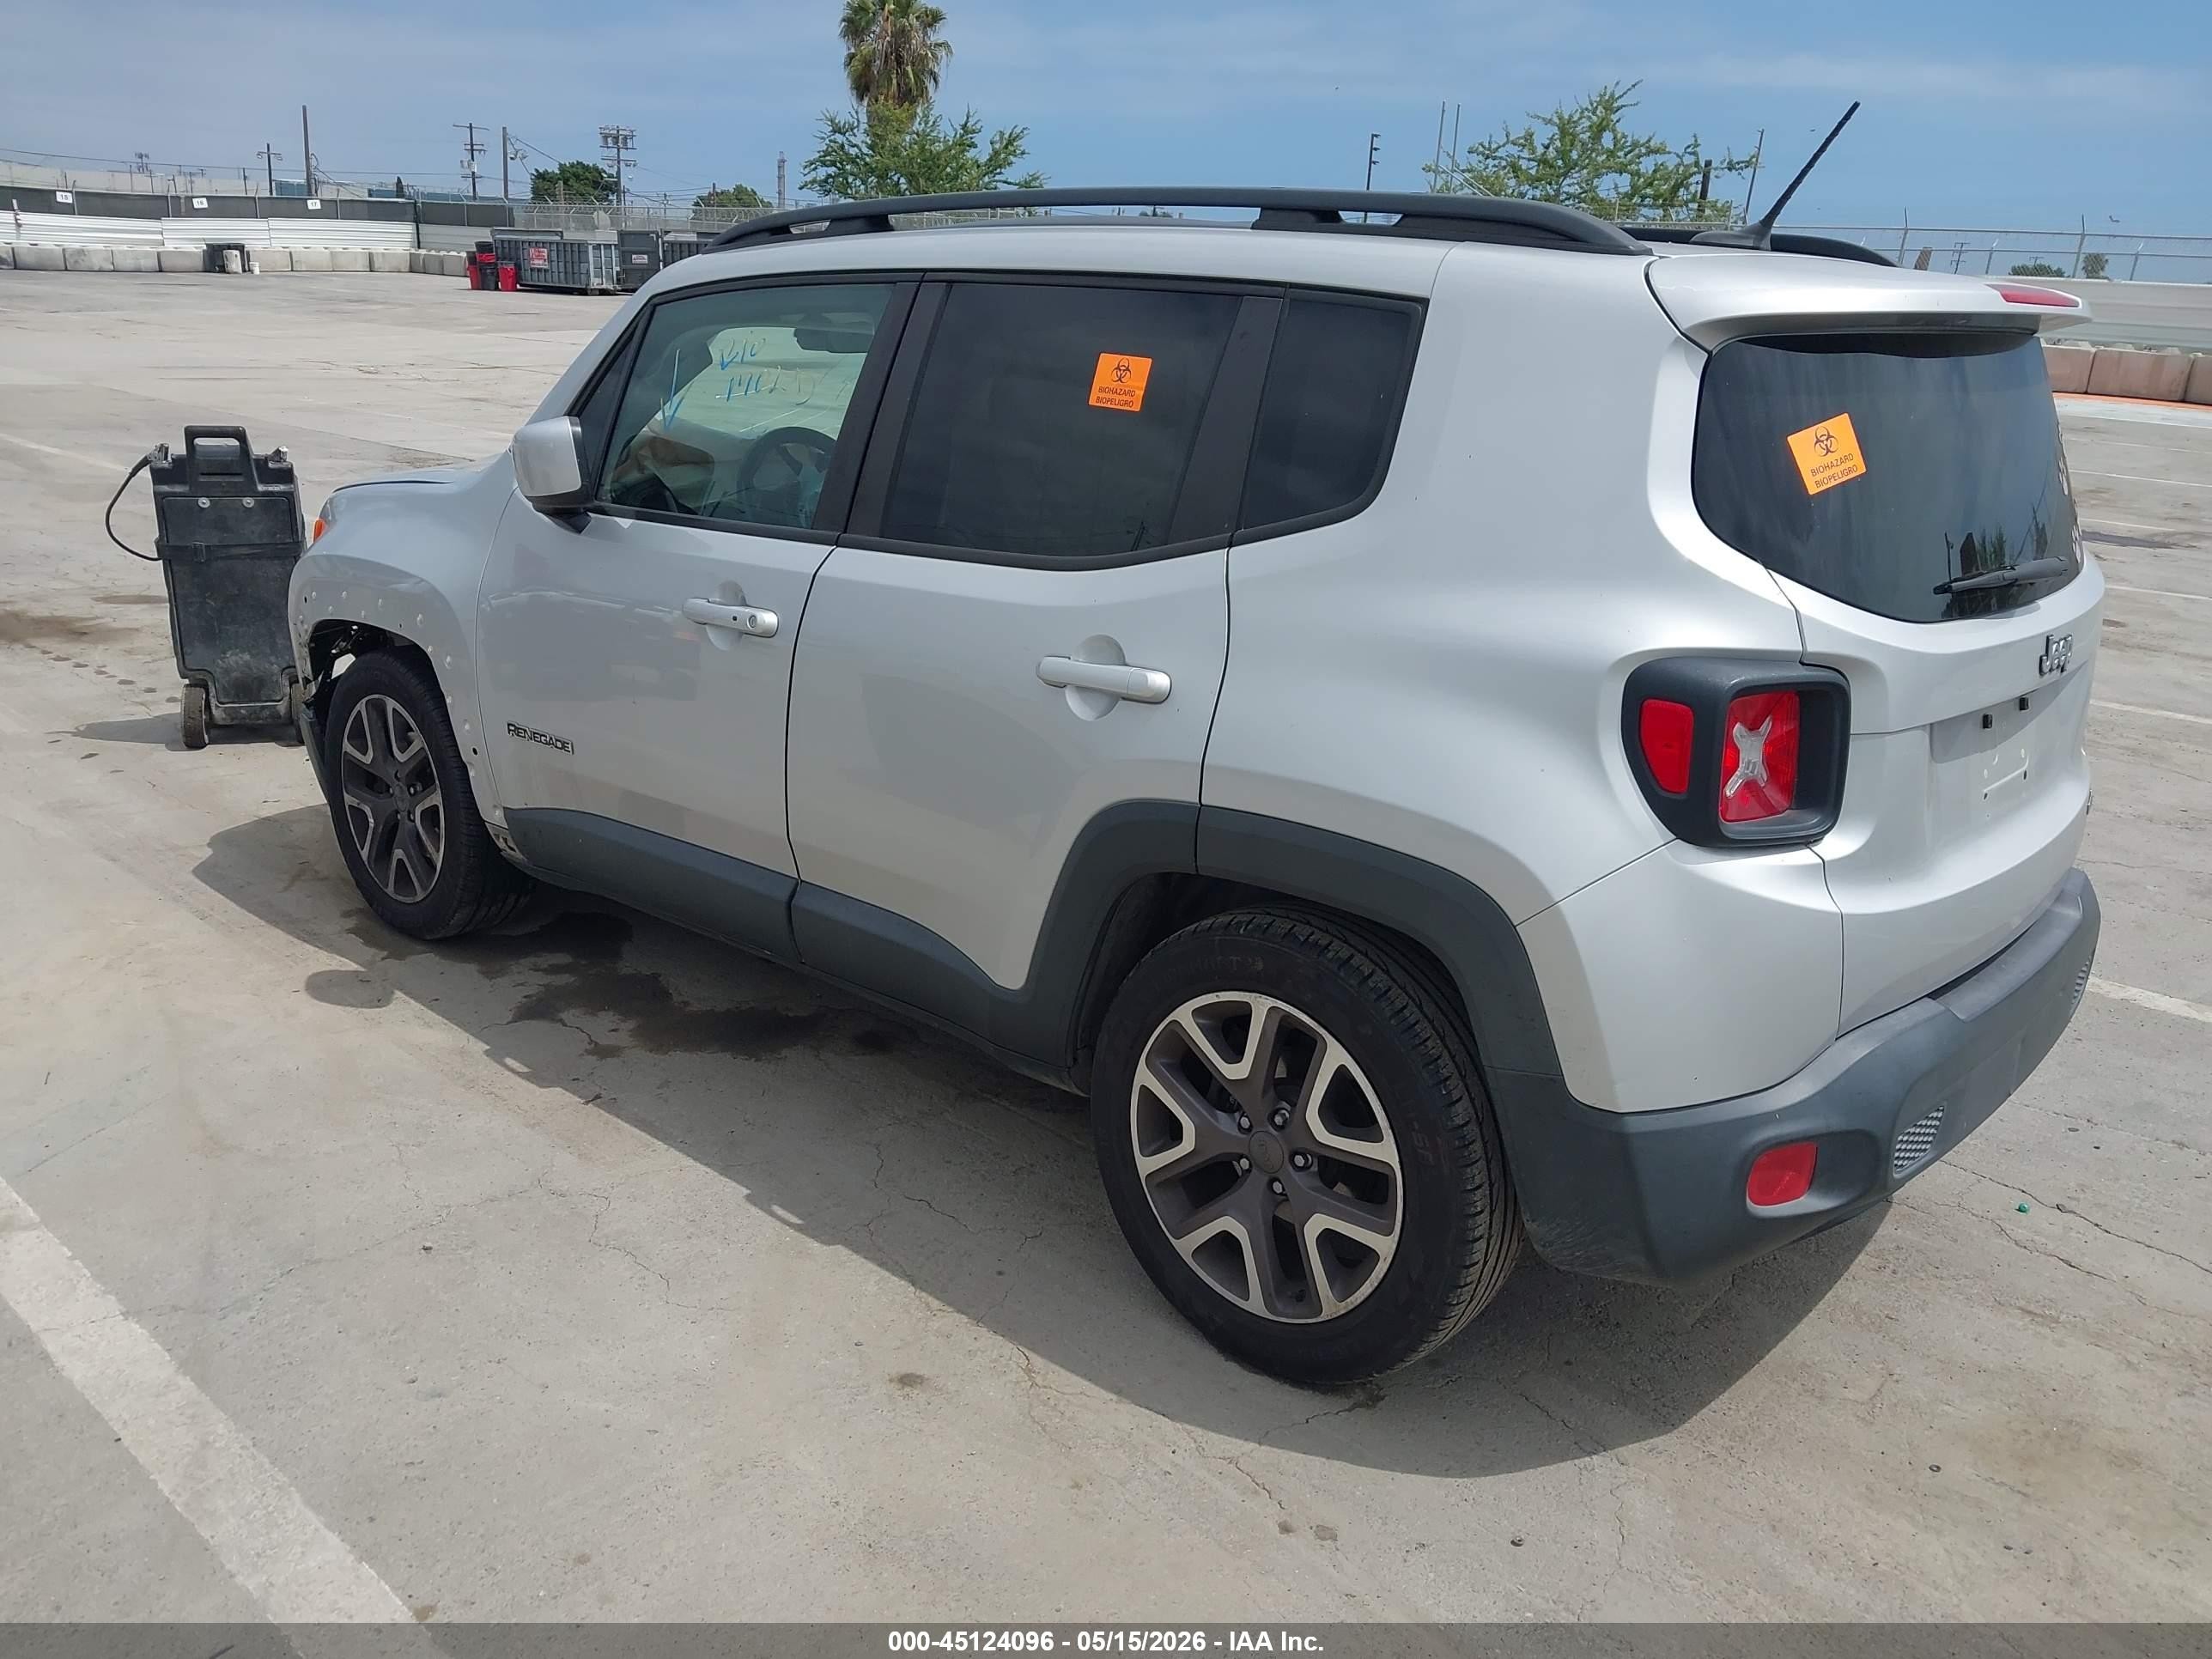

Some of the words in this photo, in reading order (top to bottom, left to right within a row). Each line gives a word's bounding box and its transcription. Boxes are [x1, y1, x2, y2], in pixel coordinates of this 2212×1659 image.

[1095, 396, 1134, 409] BIOPELIGRO
[1098, 386, 1136, 398] BIOHAZARD
[1810, 453, 1854, 477] BIOHAZARD
[1814, 464, 1858, 489] BIOPELIGRO
[2039, 634, 2073, 677] Jeep
[507, 722, 572, 754] RENEGADE
